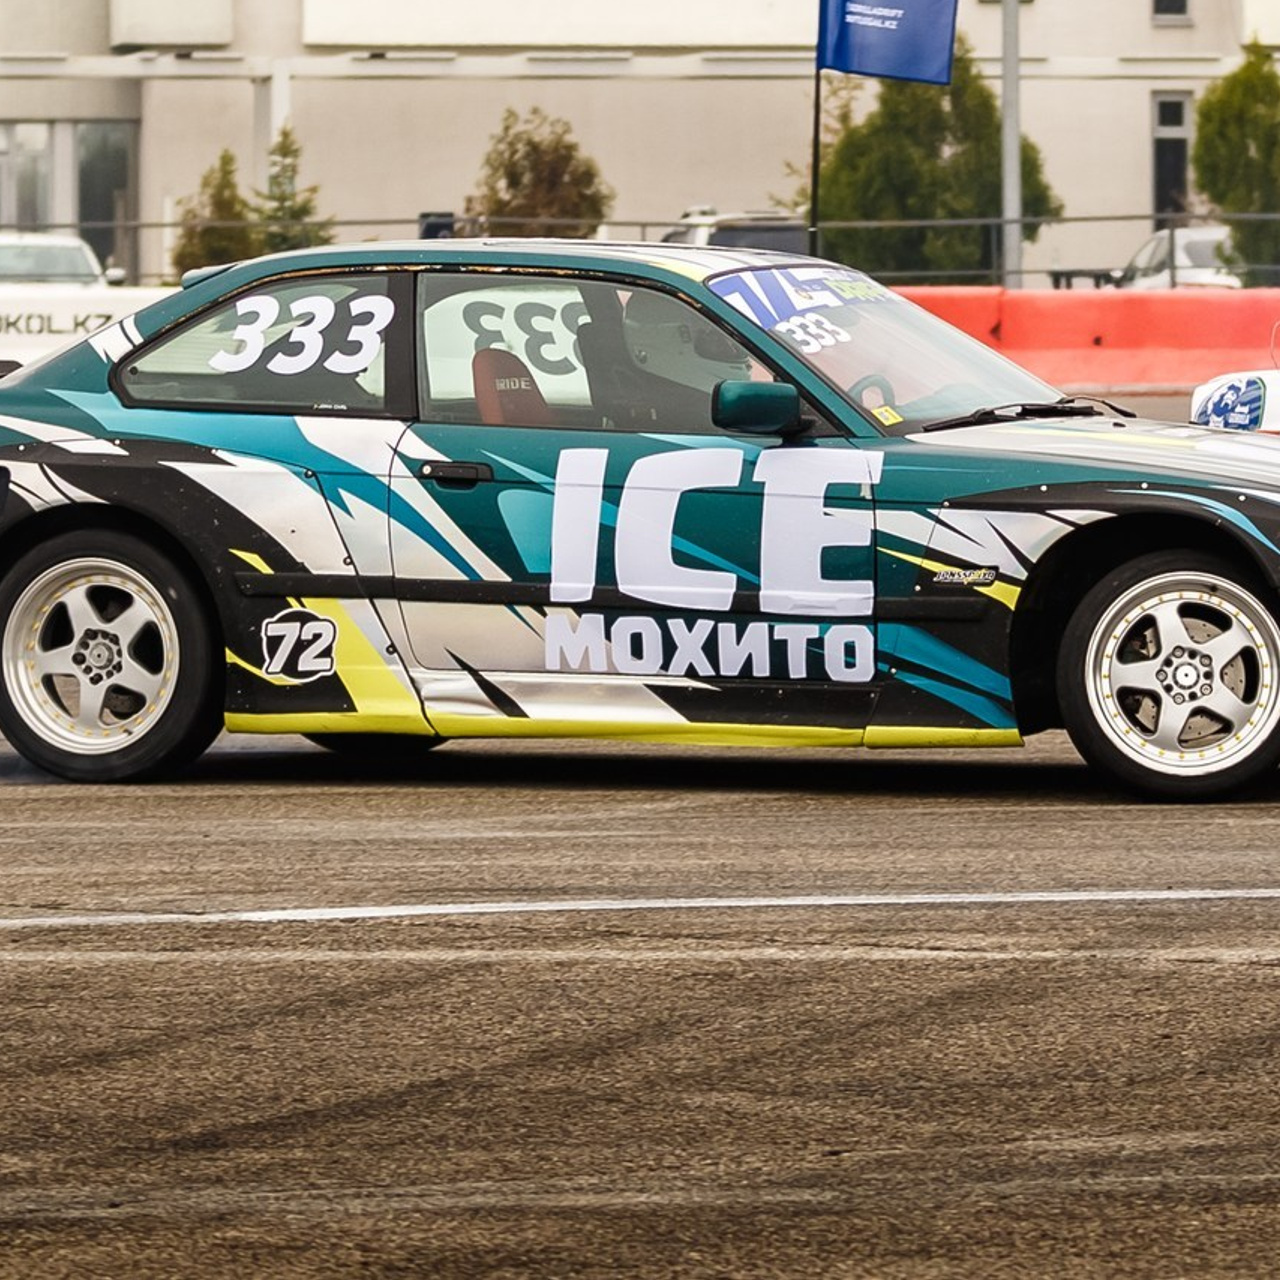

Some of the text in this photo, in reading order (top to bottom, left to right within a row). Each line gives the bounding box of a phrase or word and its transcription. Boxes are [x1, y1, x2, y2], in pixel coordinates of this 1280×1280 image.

[208, 294, 396, 376] 333
[775, 312, 852, 355] 333
[549, 448, 885, 617] ICE
[267, 621, 335, 673] 72
[544, 612, 875, 683] МОХИТО
